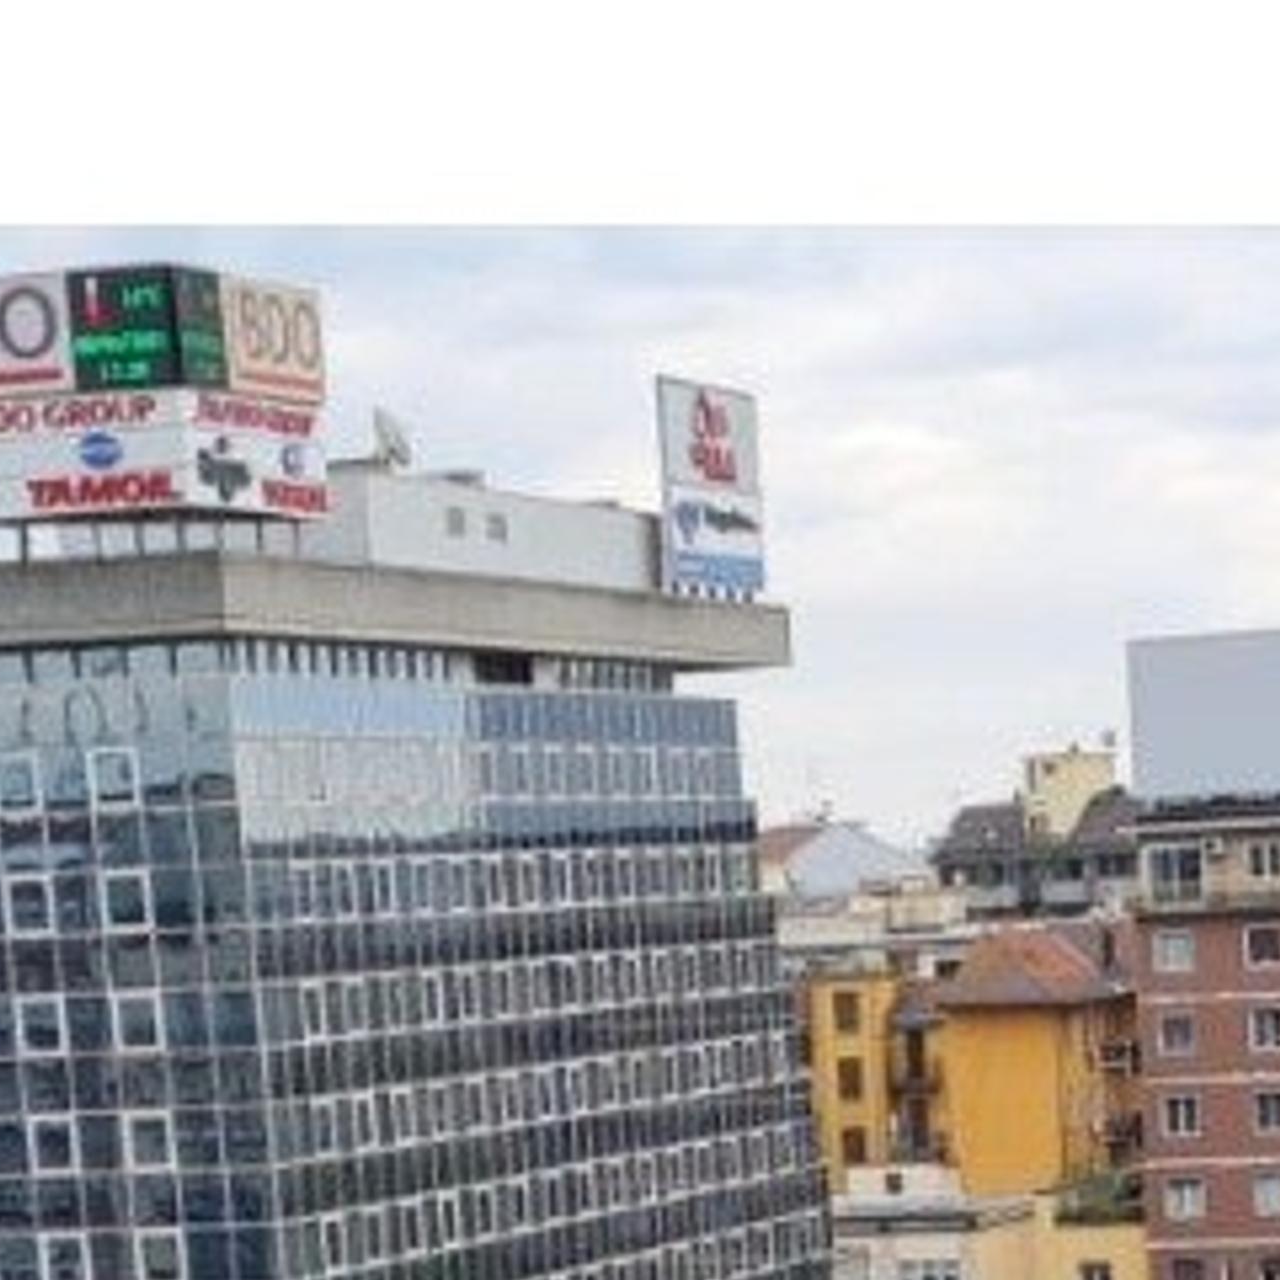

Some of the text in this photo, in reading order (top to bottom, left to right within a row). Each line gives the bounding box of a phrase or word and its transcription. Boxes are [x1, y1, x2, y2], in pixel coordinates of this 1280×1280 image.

[239, 288, 321, 370] BDO
[43, 396, 156, 428] GROUP
[26, 473, 184, 507] TAMOIL
